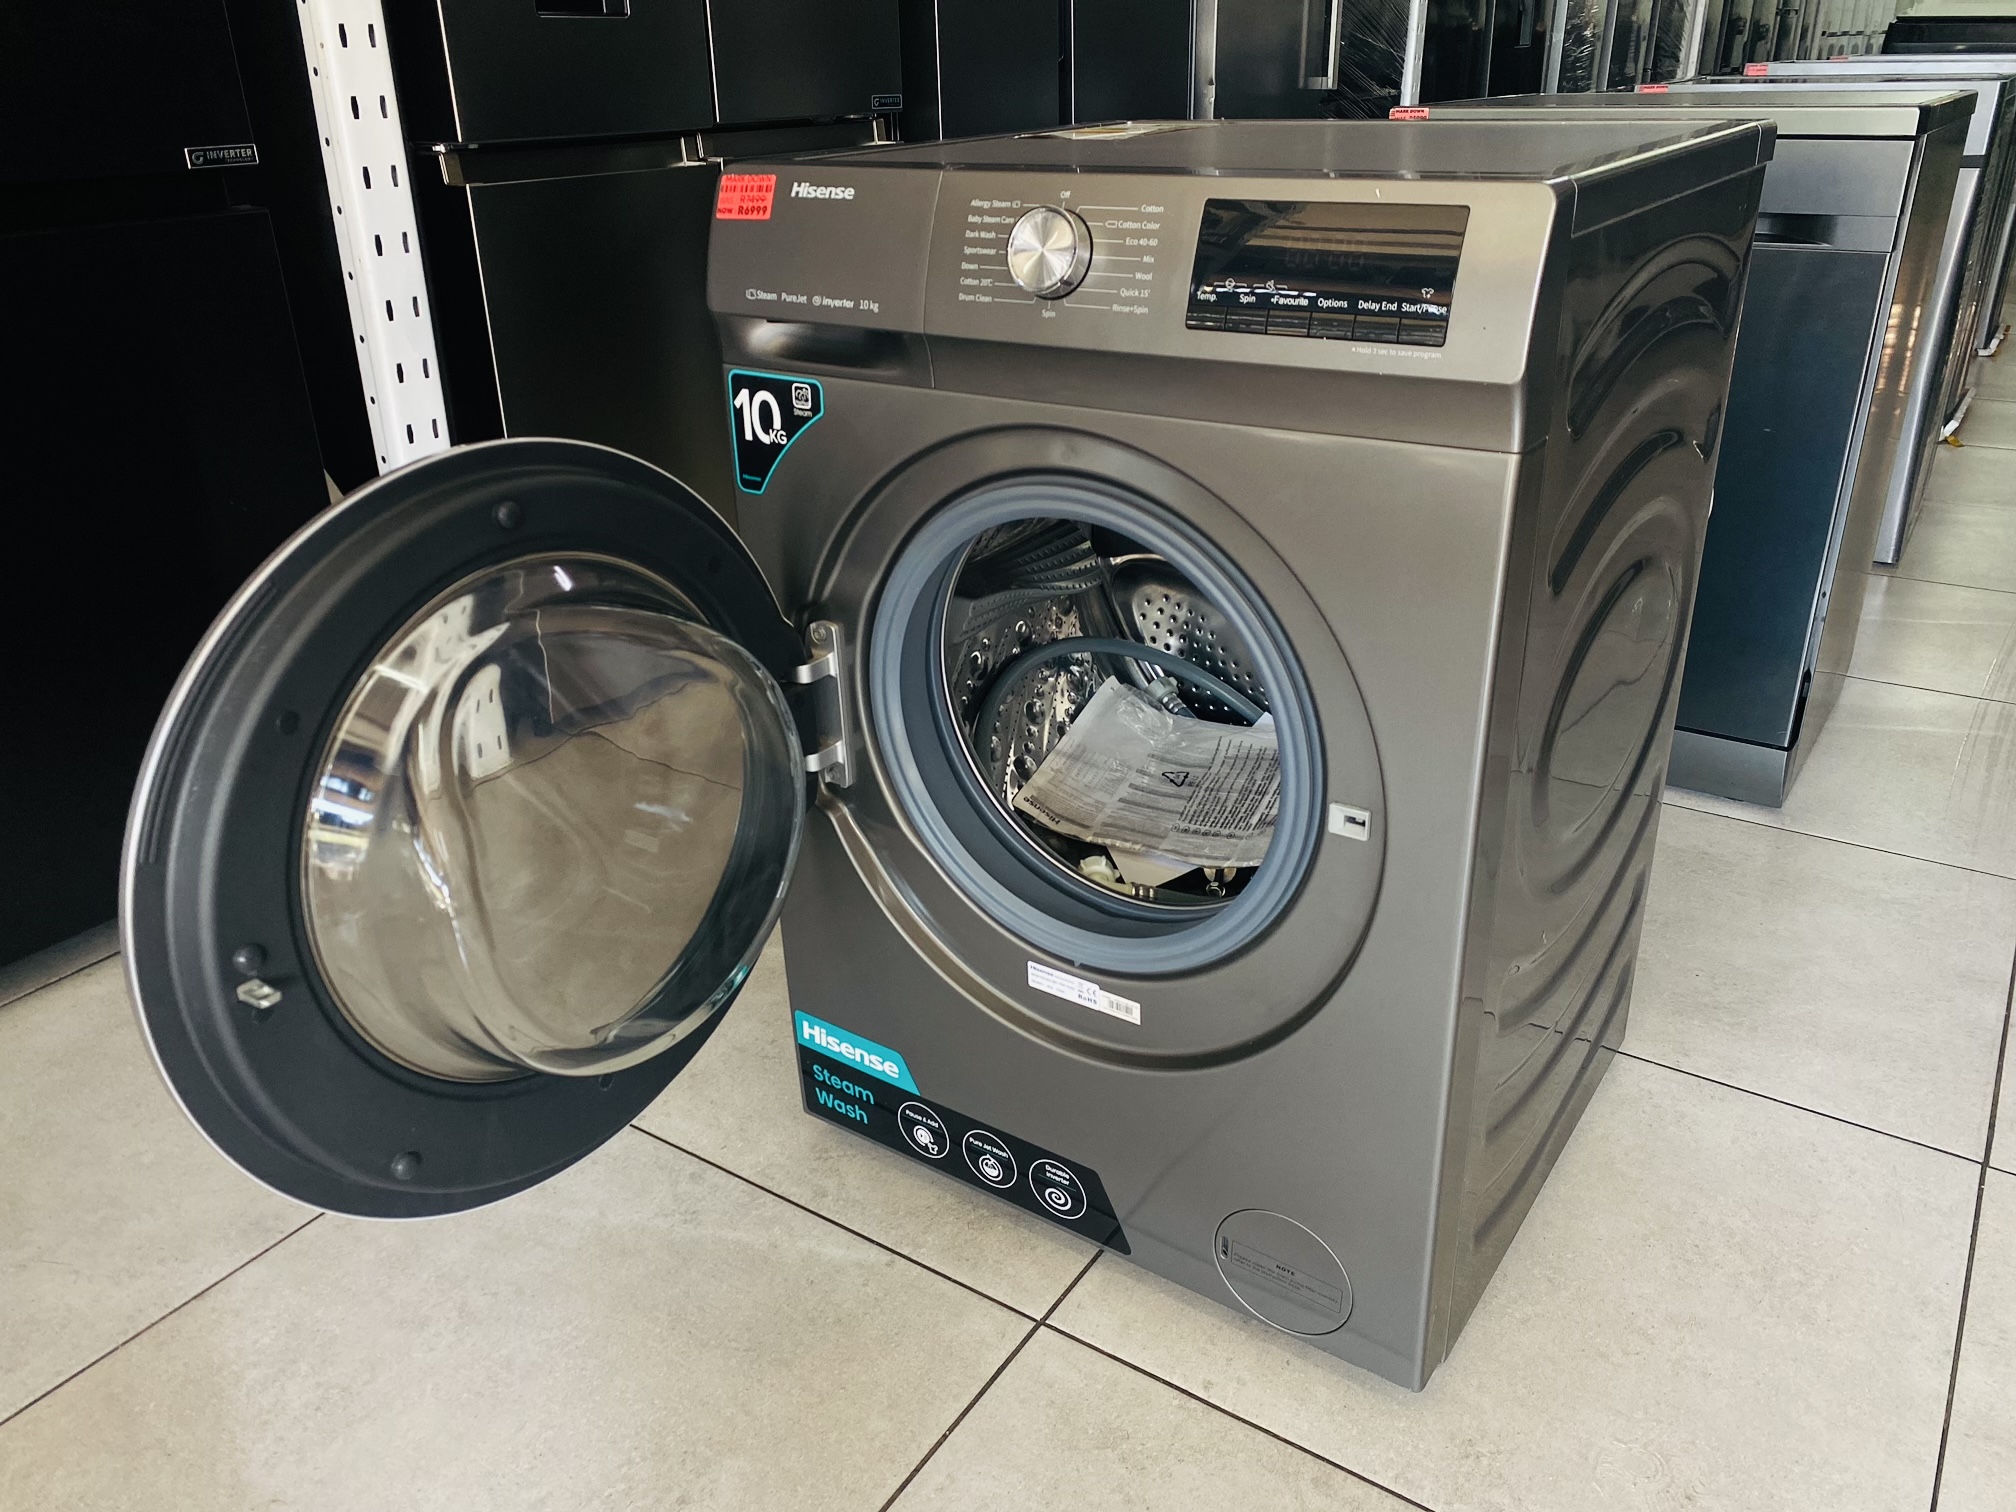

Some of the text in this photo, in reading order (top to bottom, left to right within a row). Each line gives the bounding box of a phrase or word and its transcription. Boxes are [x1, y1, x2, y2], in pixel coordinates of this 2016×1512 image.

[206, 148, 253, 159] INVERTER
[790, 182, 855, 200] Hisense
[1060, 190, 1071, 199] Off
[970, 199, 1011, 209] Allergy Steam
[1141, 204, 1164, 213] Cotton
[738, 205, 767, 215] R6999
[968, 214, 1014, 224] Baby Steam Care
[1118, 220, 1160, 230] Cotton Color
[965, 230, 979, 238] Dark
[1126, 237, 1158, 246] Eco 40-60
[964, 246, 997, 255] Sportswear
[1143, 255, 1155, 263] Mix
[961, 262, 979, 270] Down
[960, 277, 979, 286] Cotton
[1135, 272, 1153, 281] Wool
[959, 293, 992, 302] Drum Clean
[1120, 288, 1138, 297] Quick
[1197, 291, 1217, 302] Temp.
[757, 290, 777, 300] Steam
[781, 292, 807, 304] PureJet
[860, 300, 869, 310] 10
[870, 300, 879, 313] kg
[1239, 294, 1256, 304] Spin
[1317, 298, 1348, 309] Options
[1112, 304, 1148, 314] Rinse+Spin
[1358, 300, 1398, 312] Delay End
[1042, 309, 1056, 318] Spin
[1413, 351, 1442, 360] program
[733, 388, 788, 445] 10 KG
[793, 407, 813, 417] Steam
[1023, 796, 1061, 825] Hisense
[802, 1020, 899, 1078] Hisense
[813, 1064, 874, 1104] Steam
[815, 1087, 868, 1124] Wash
[905, 1109, 922, 1121] Pause
[927, 1118, 939, 1128] Add
[969, 1136, 1009, 1159] Pure Jet Wash
[1045, 1164, 1070, 1180] Durable
[1046, 1171, 1070, 1186] Inverter
[1276, 1264, 1295, 1276] NOTE
